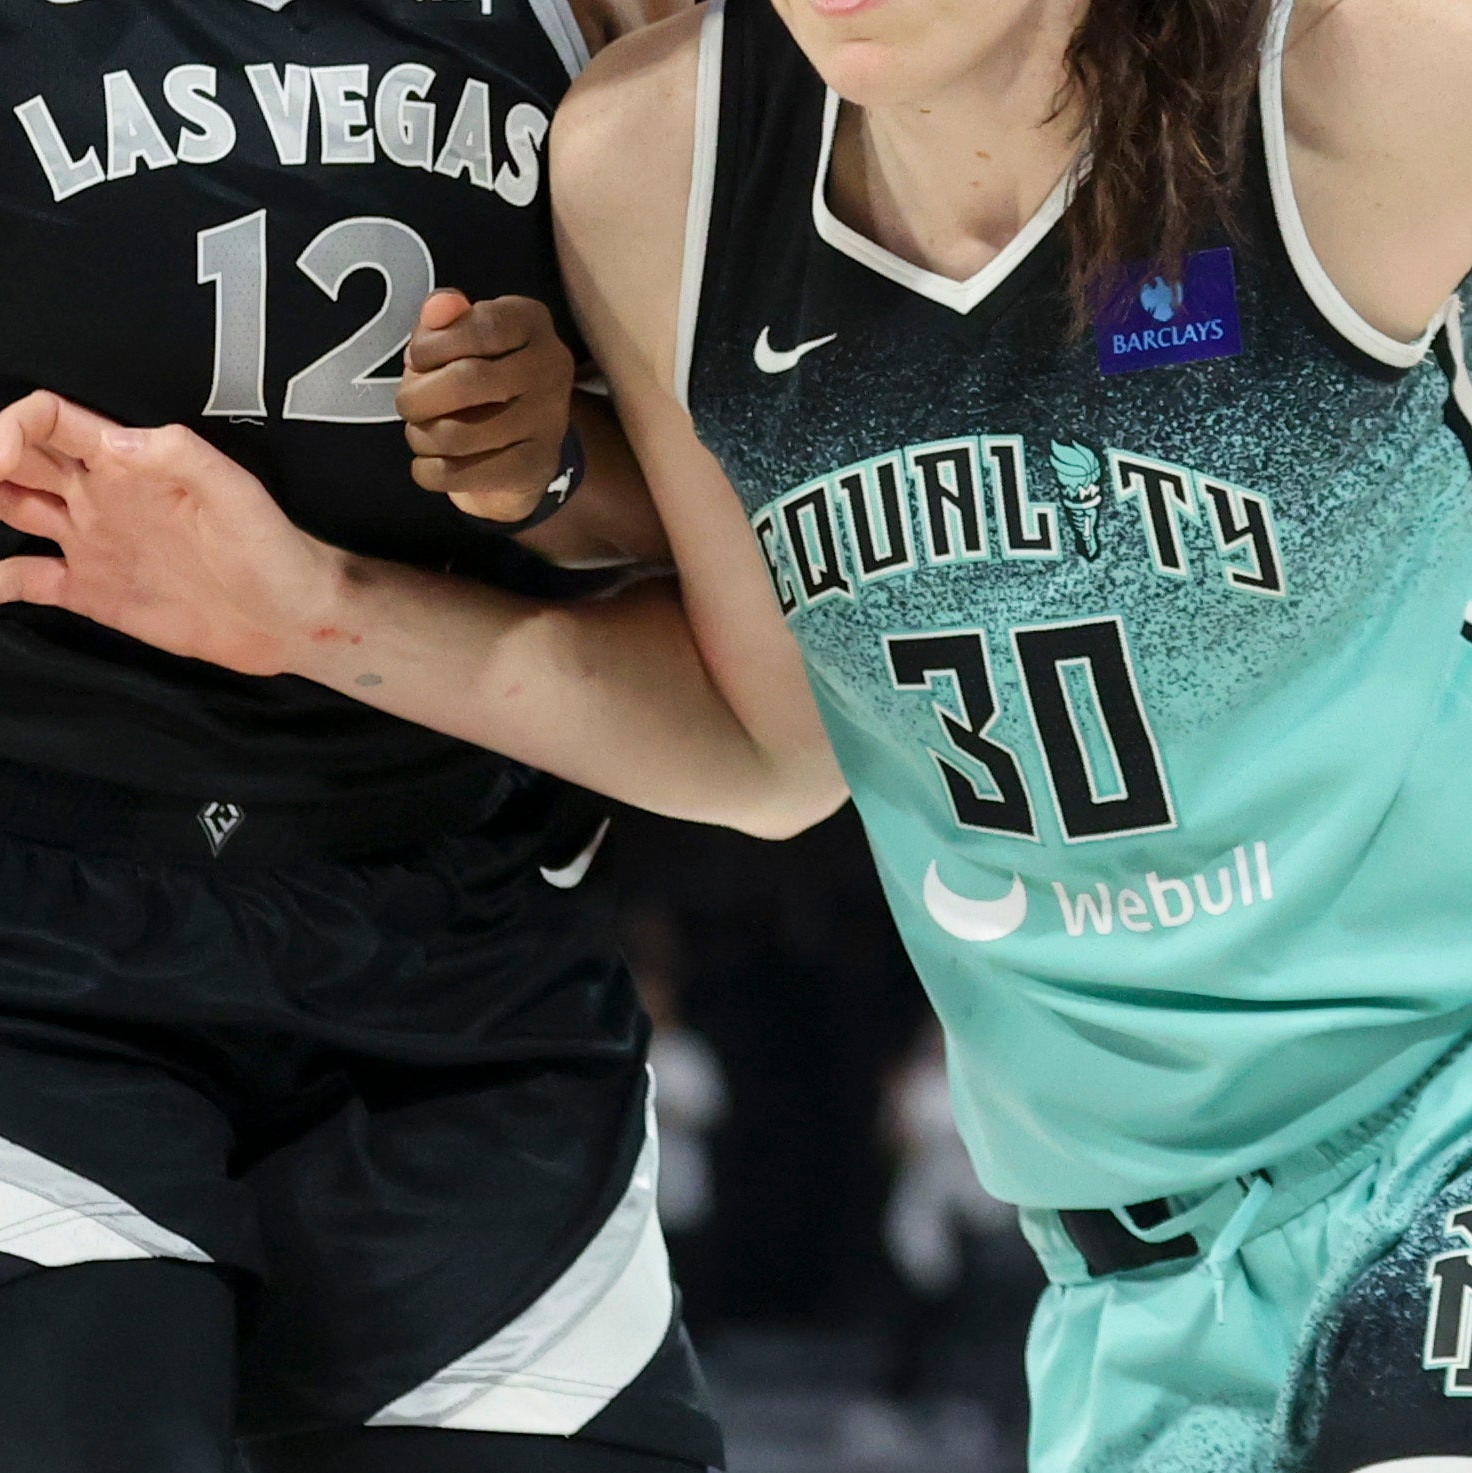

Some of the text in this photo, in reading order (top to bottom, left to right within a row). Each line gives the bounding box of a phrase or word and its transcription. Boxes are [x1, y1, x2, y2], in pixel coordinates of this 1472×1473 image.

[13, 63, 549, 207] LAS VEGAS
[197, 208, 435, 423] 12
[1112, 319, 1224, 355] BARCLAYS
[881, 616, 1179, 845] 30
[1052, 841, 1274, 938] Webull
